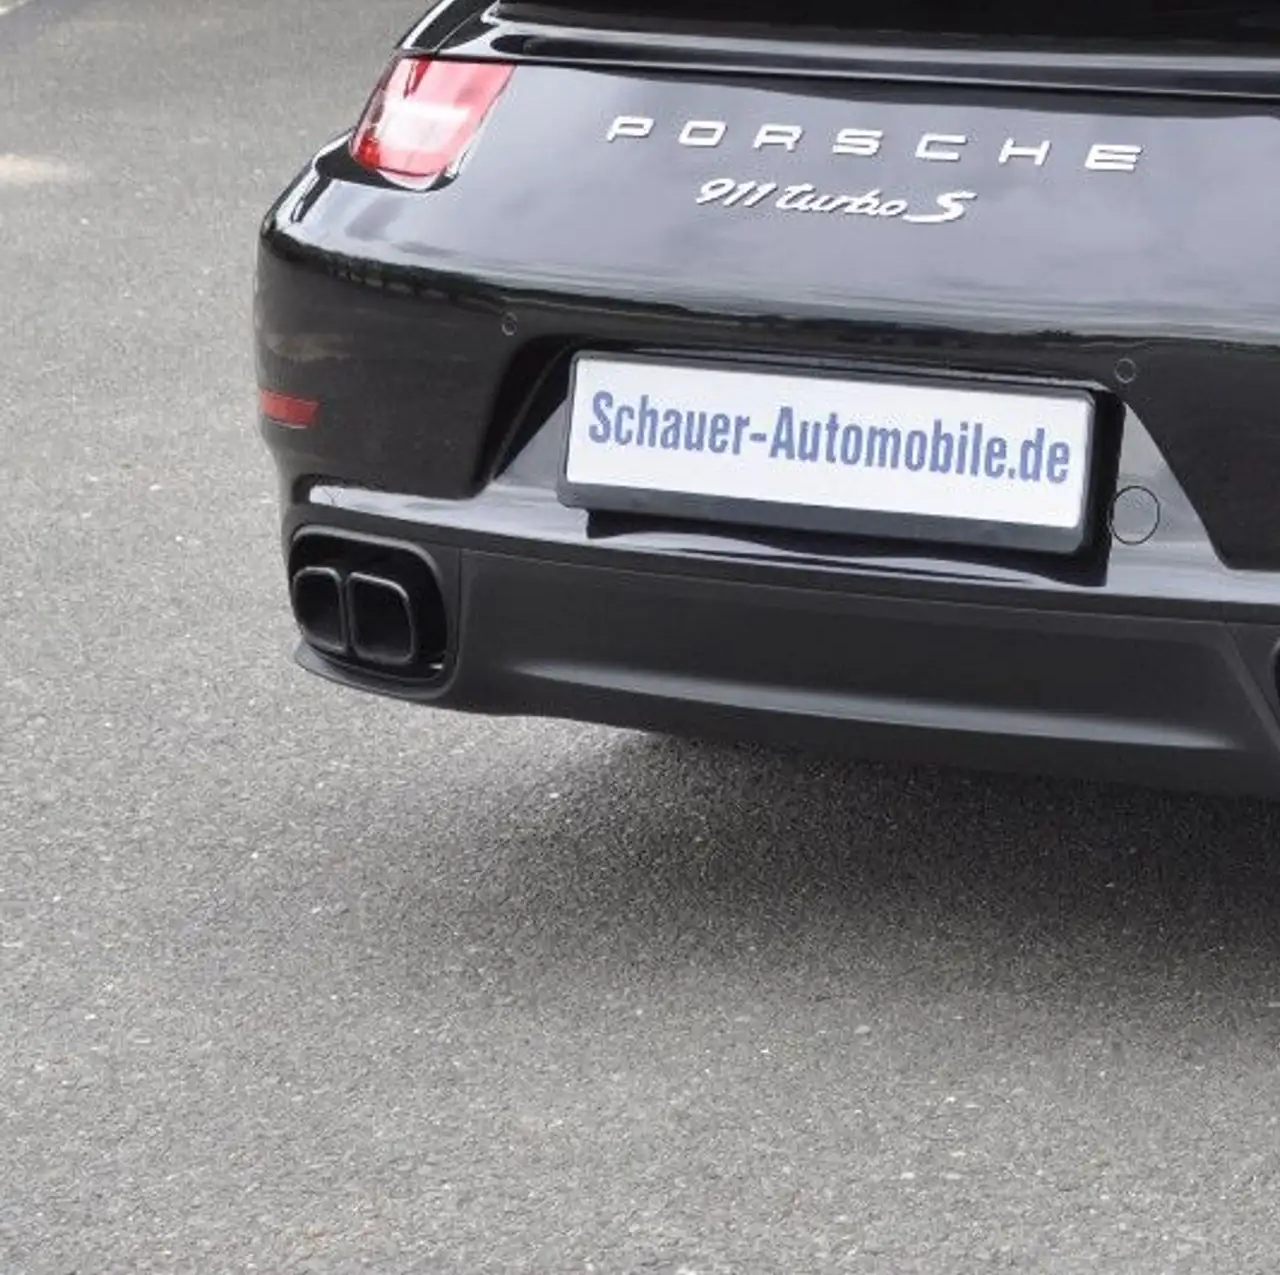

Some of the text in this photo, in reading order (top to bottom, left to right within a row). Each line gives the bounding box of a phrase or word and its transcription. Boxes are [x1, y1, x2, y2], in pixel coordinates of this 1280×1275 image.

[605, 115, 1143, 171] PORSCHE
[696, 177, 978, 223] 911 turbo S
[588, 389, 1071, 484] Schauer-Automobile.de
